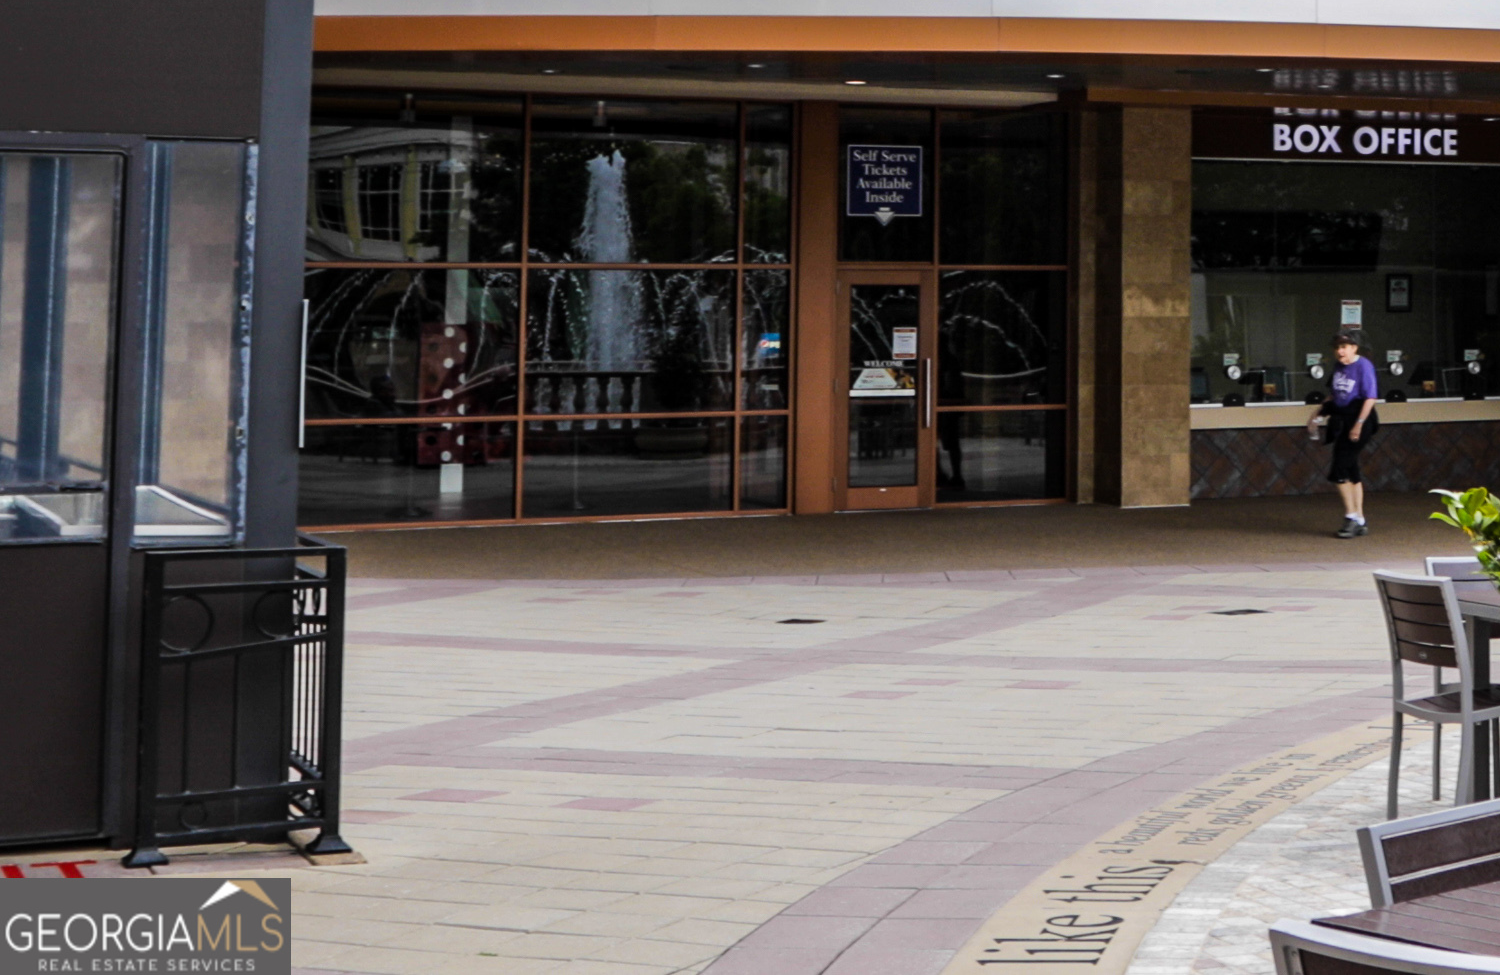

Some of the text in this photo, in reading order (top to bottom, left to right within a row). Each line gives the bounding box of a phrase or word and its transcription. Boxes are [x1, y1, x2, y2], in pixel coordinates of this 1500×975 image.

[1273, 123, 1459, 156] BOX OFFICE
[853, 150, 917, 163] Self Serve
[862, 164, 908, 176] Tickets
[856, 177, 913, 190] Available
[865, 191, 905, 203] Inside
[1094, 810, 1192, 847] beautiful
[1175, 787, 1235, 809] world
[976, 914, 1124, 966] like
